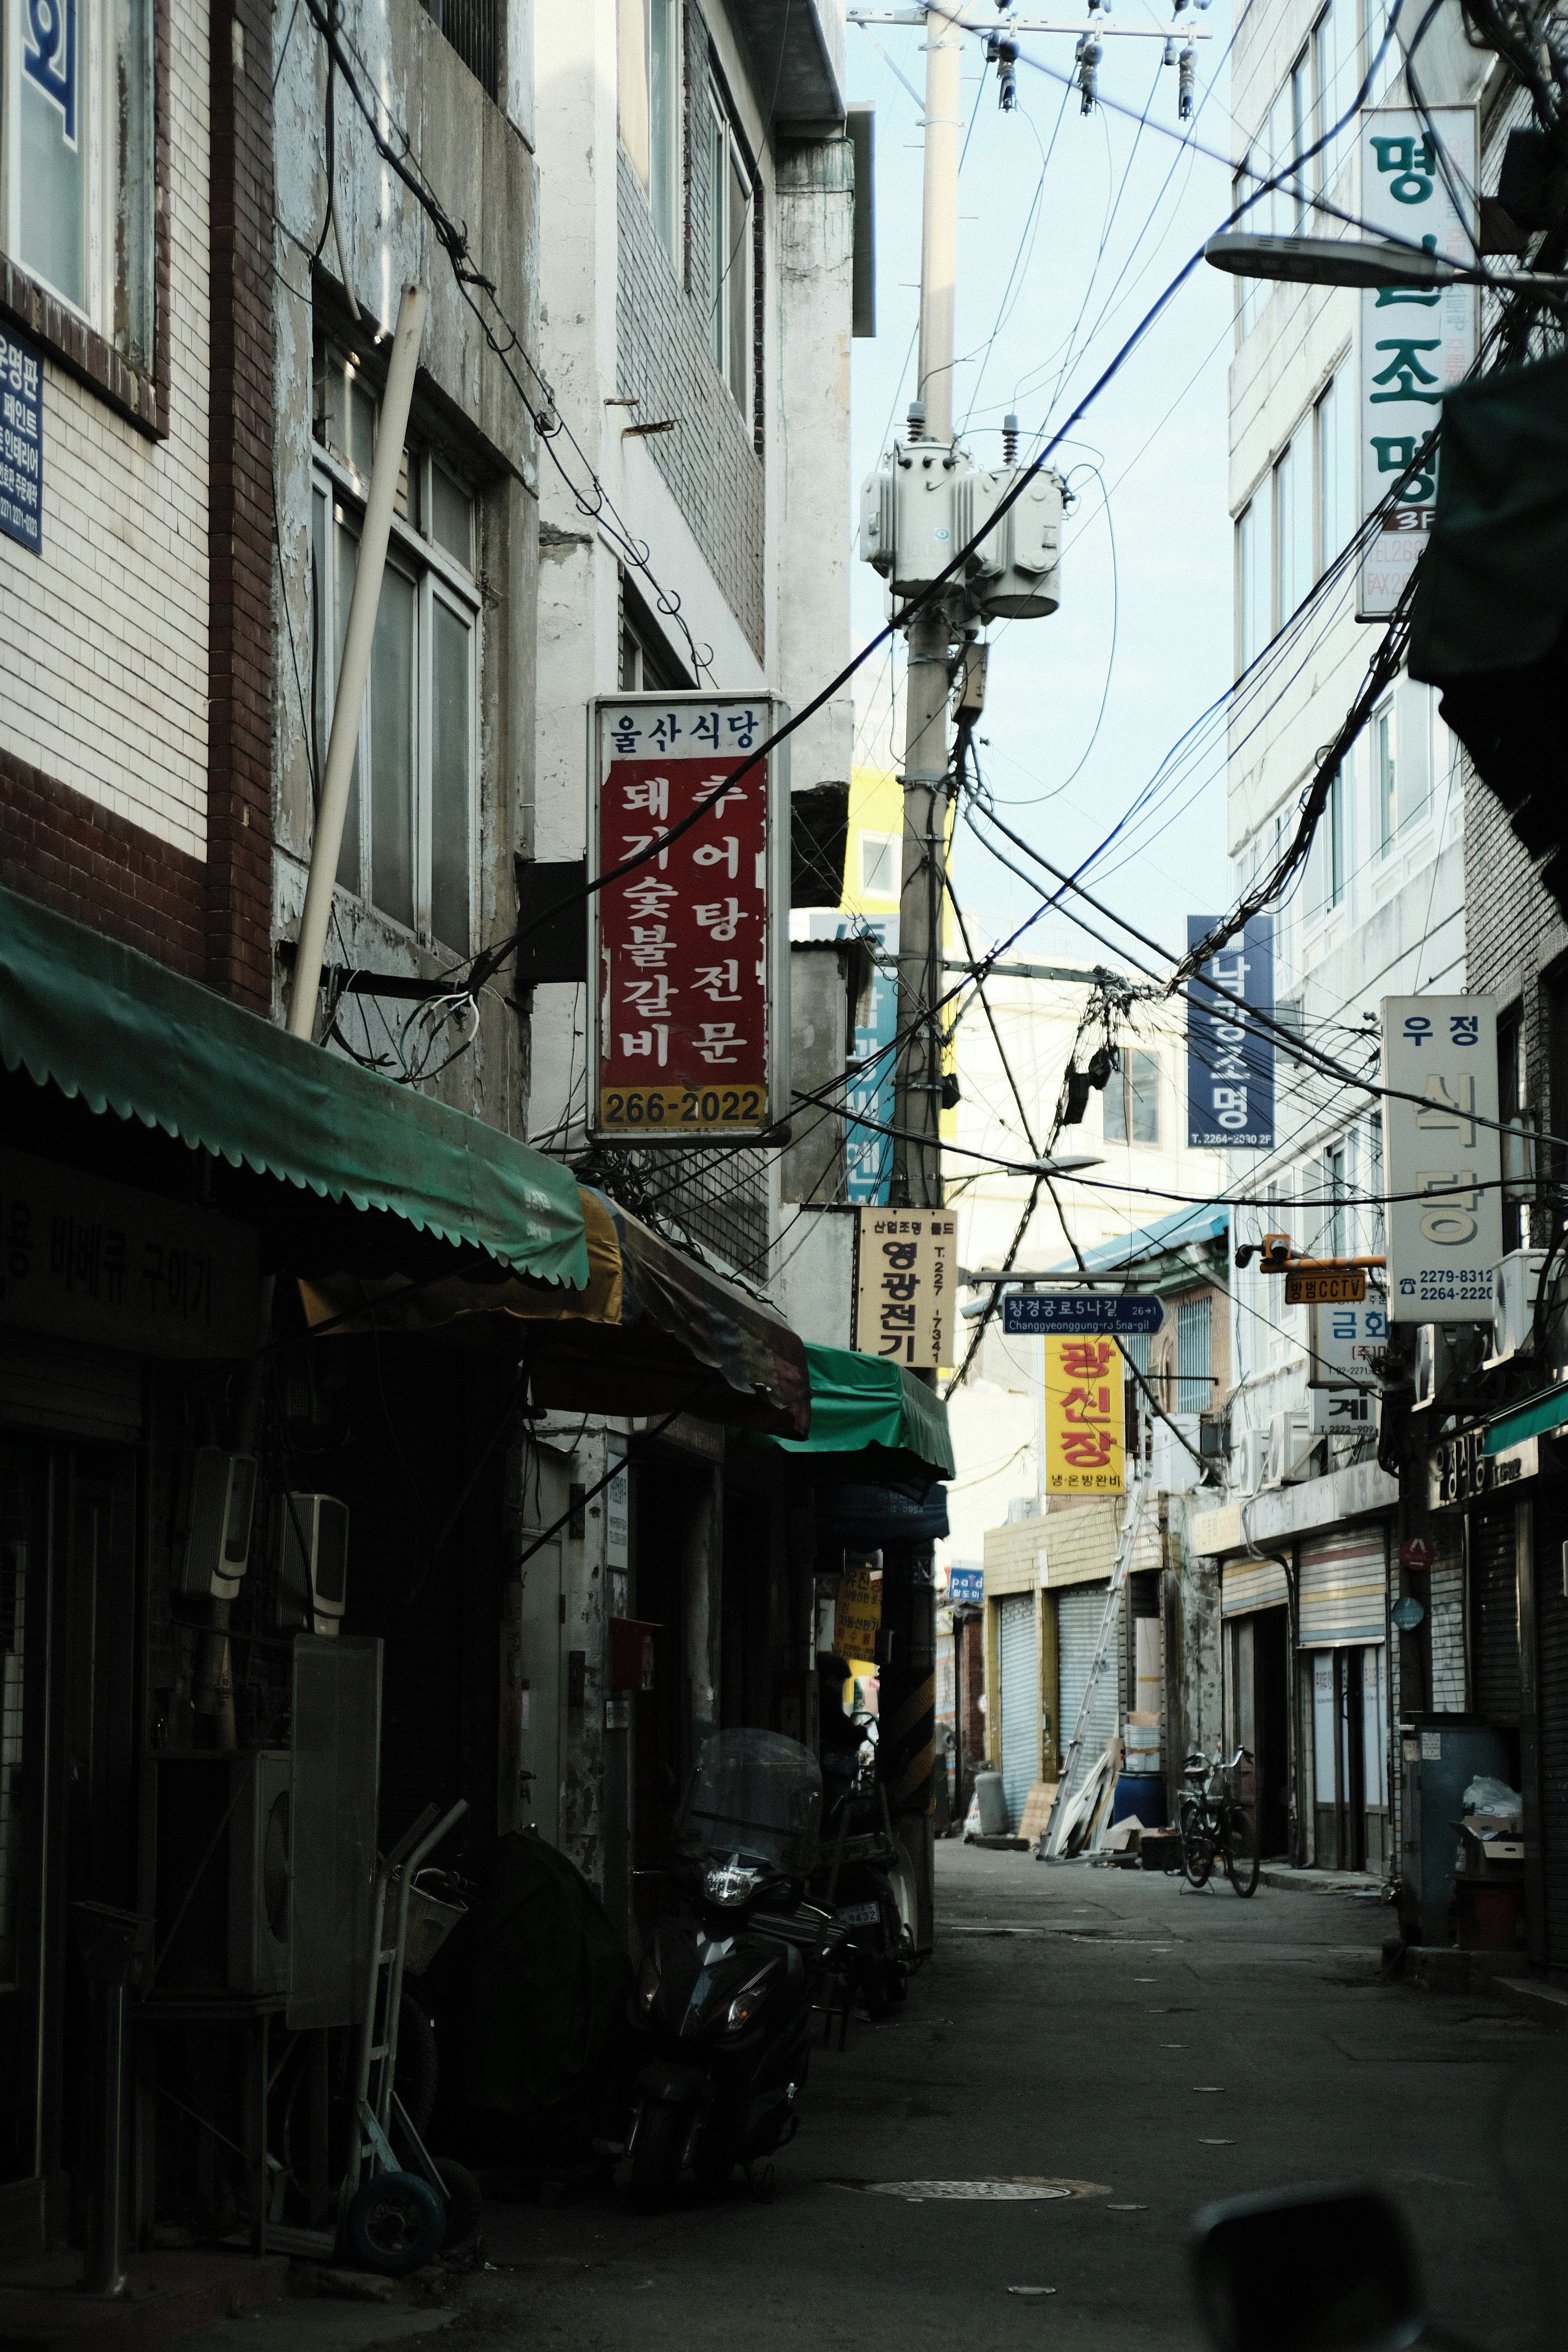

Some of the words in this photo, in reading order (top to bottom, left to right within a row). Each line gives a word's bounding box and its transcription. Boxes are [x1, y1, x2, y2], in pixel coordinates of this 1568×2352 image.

[611, 711, 759, 753] 울산식당
[1403, 1016, 1479, 1046] 우정
[606, 1091, 759, 1123] 266-2022
[1192, 1134, 1202, 1144] T.
[1260, 1135, 1271, 1144] 2F
[1414, 1073, 1481, 1245] 식당
[874, 1220, 922, 1235] 산업조명
[1420, 1270, 1493, 1283] 2279-8312
[878, 1242, 921, 1362] 영광전기
[1010, 1300, 1117, 1317] 창경궁로5나길
[1009, 1320, 1113, 1332] Changgyeonggung-ro
[1116, 1320, 1149, 1331] 5na-gil
[1060, 1342, 1117, 1468] 광신장
